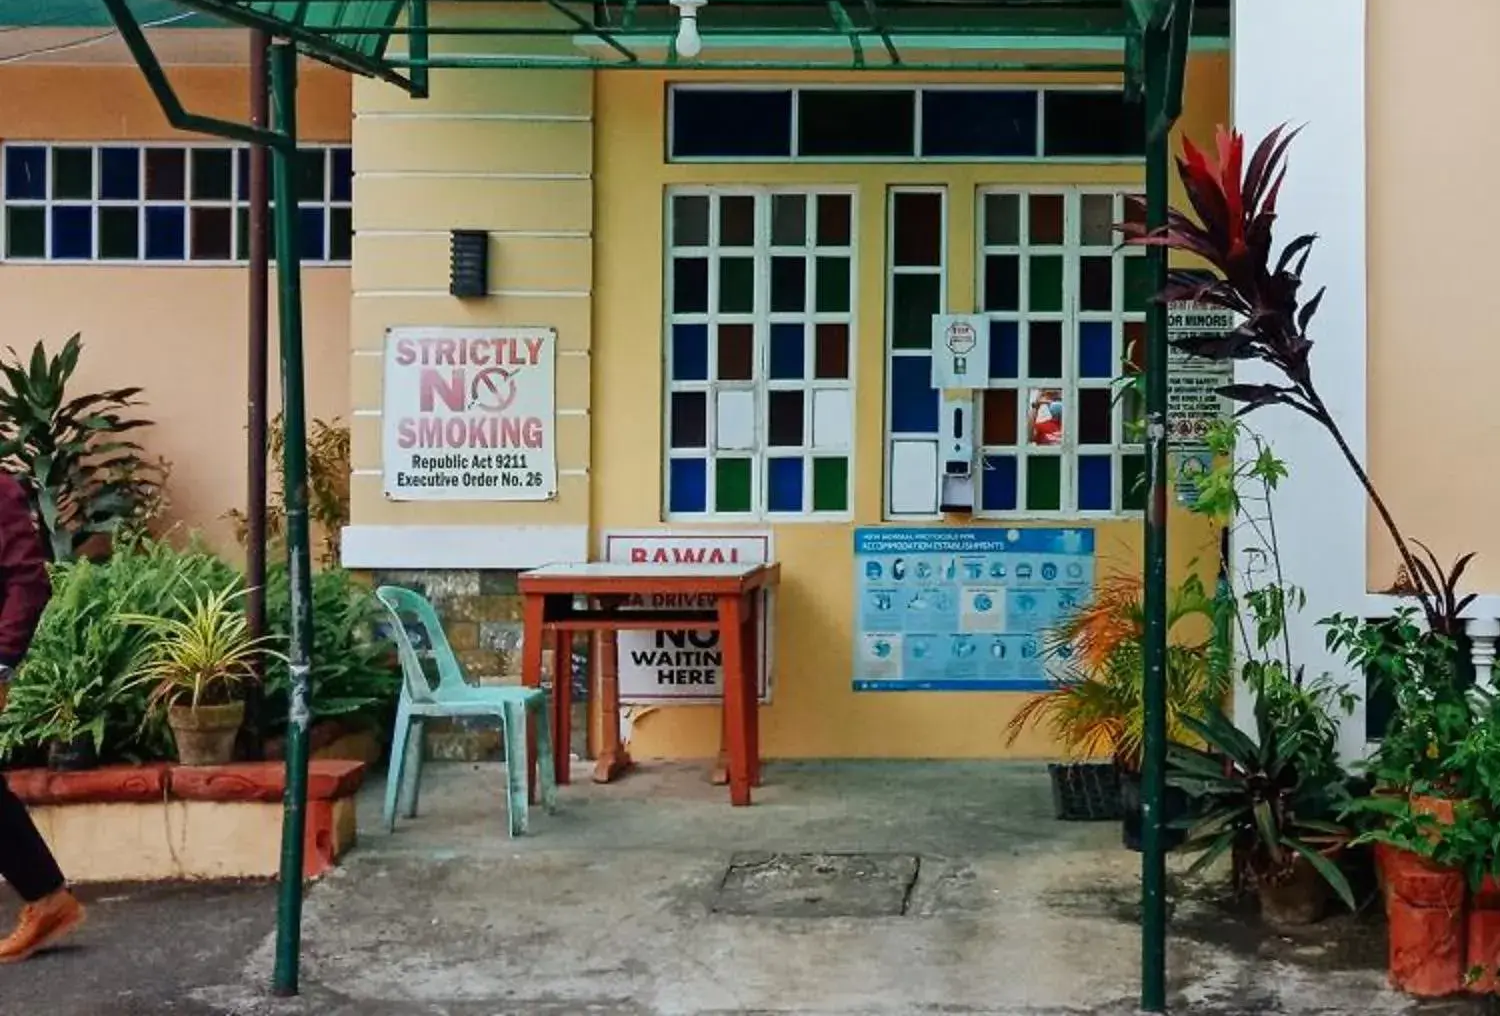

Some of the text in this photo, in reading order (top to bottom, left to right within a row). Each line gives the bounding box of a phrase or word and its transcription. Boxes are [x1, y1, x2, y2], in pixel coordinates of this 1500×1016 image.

[395, 337, 545, 366] STRICTLY
[397, 416, 543, 450] SMOKING
[411, 454, 528, 472] Republic Act 9211
[397, 472, 543, 487] Executive Order No. 26
[630, 650, 723, 666] WAITIN
[657, 669, 715, 685] HERE
